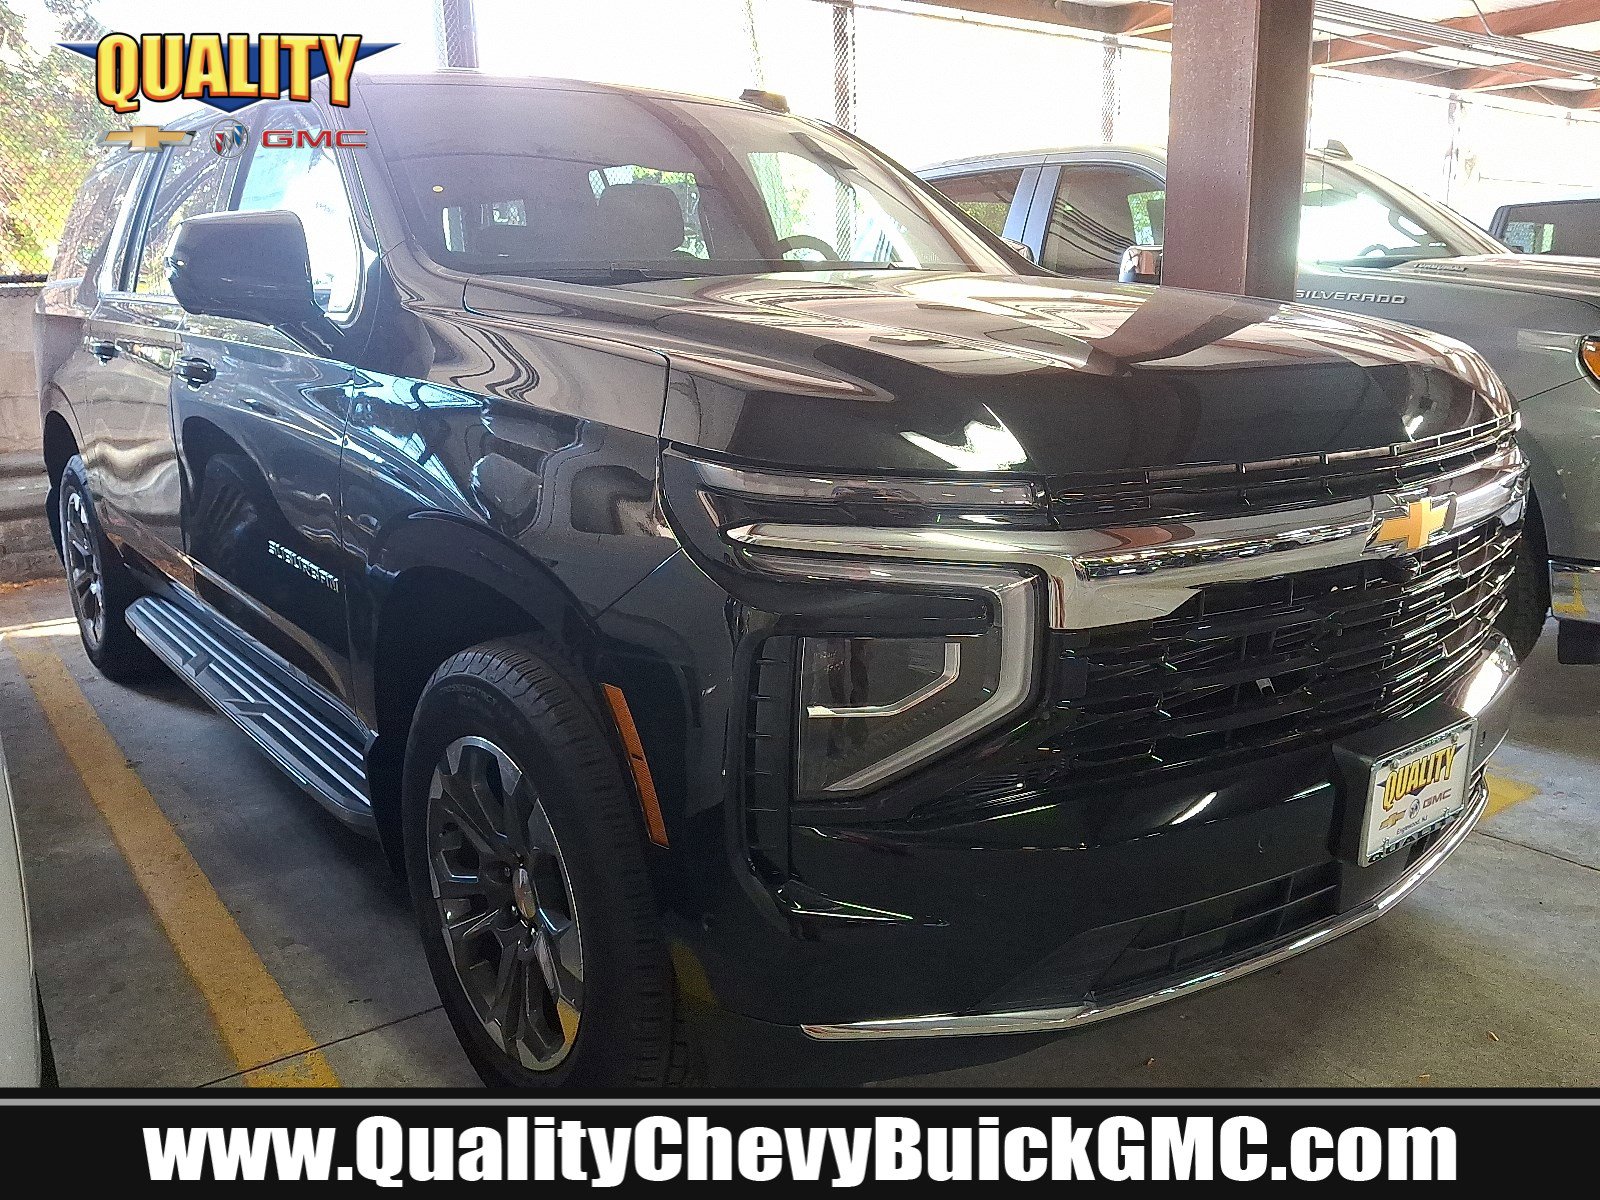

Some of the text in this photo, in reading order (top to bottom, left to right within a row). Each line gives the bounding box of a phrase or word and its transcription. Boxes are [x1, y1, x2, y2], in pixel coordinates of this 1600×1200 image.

[1295, 289, 1408, 304] SILVERADO
[1383, 743, 1458, 812] QUALITY
[1422, 788, 1452, 809] GMC
